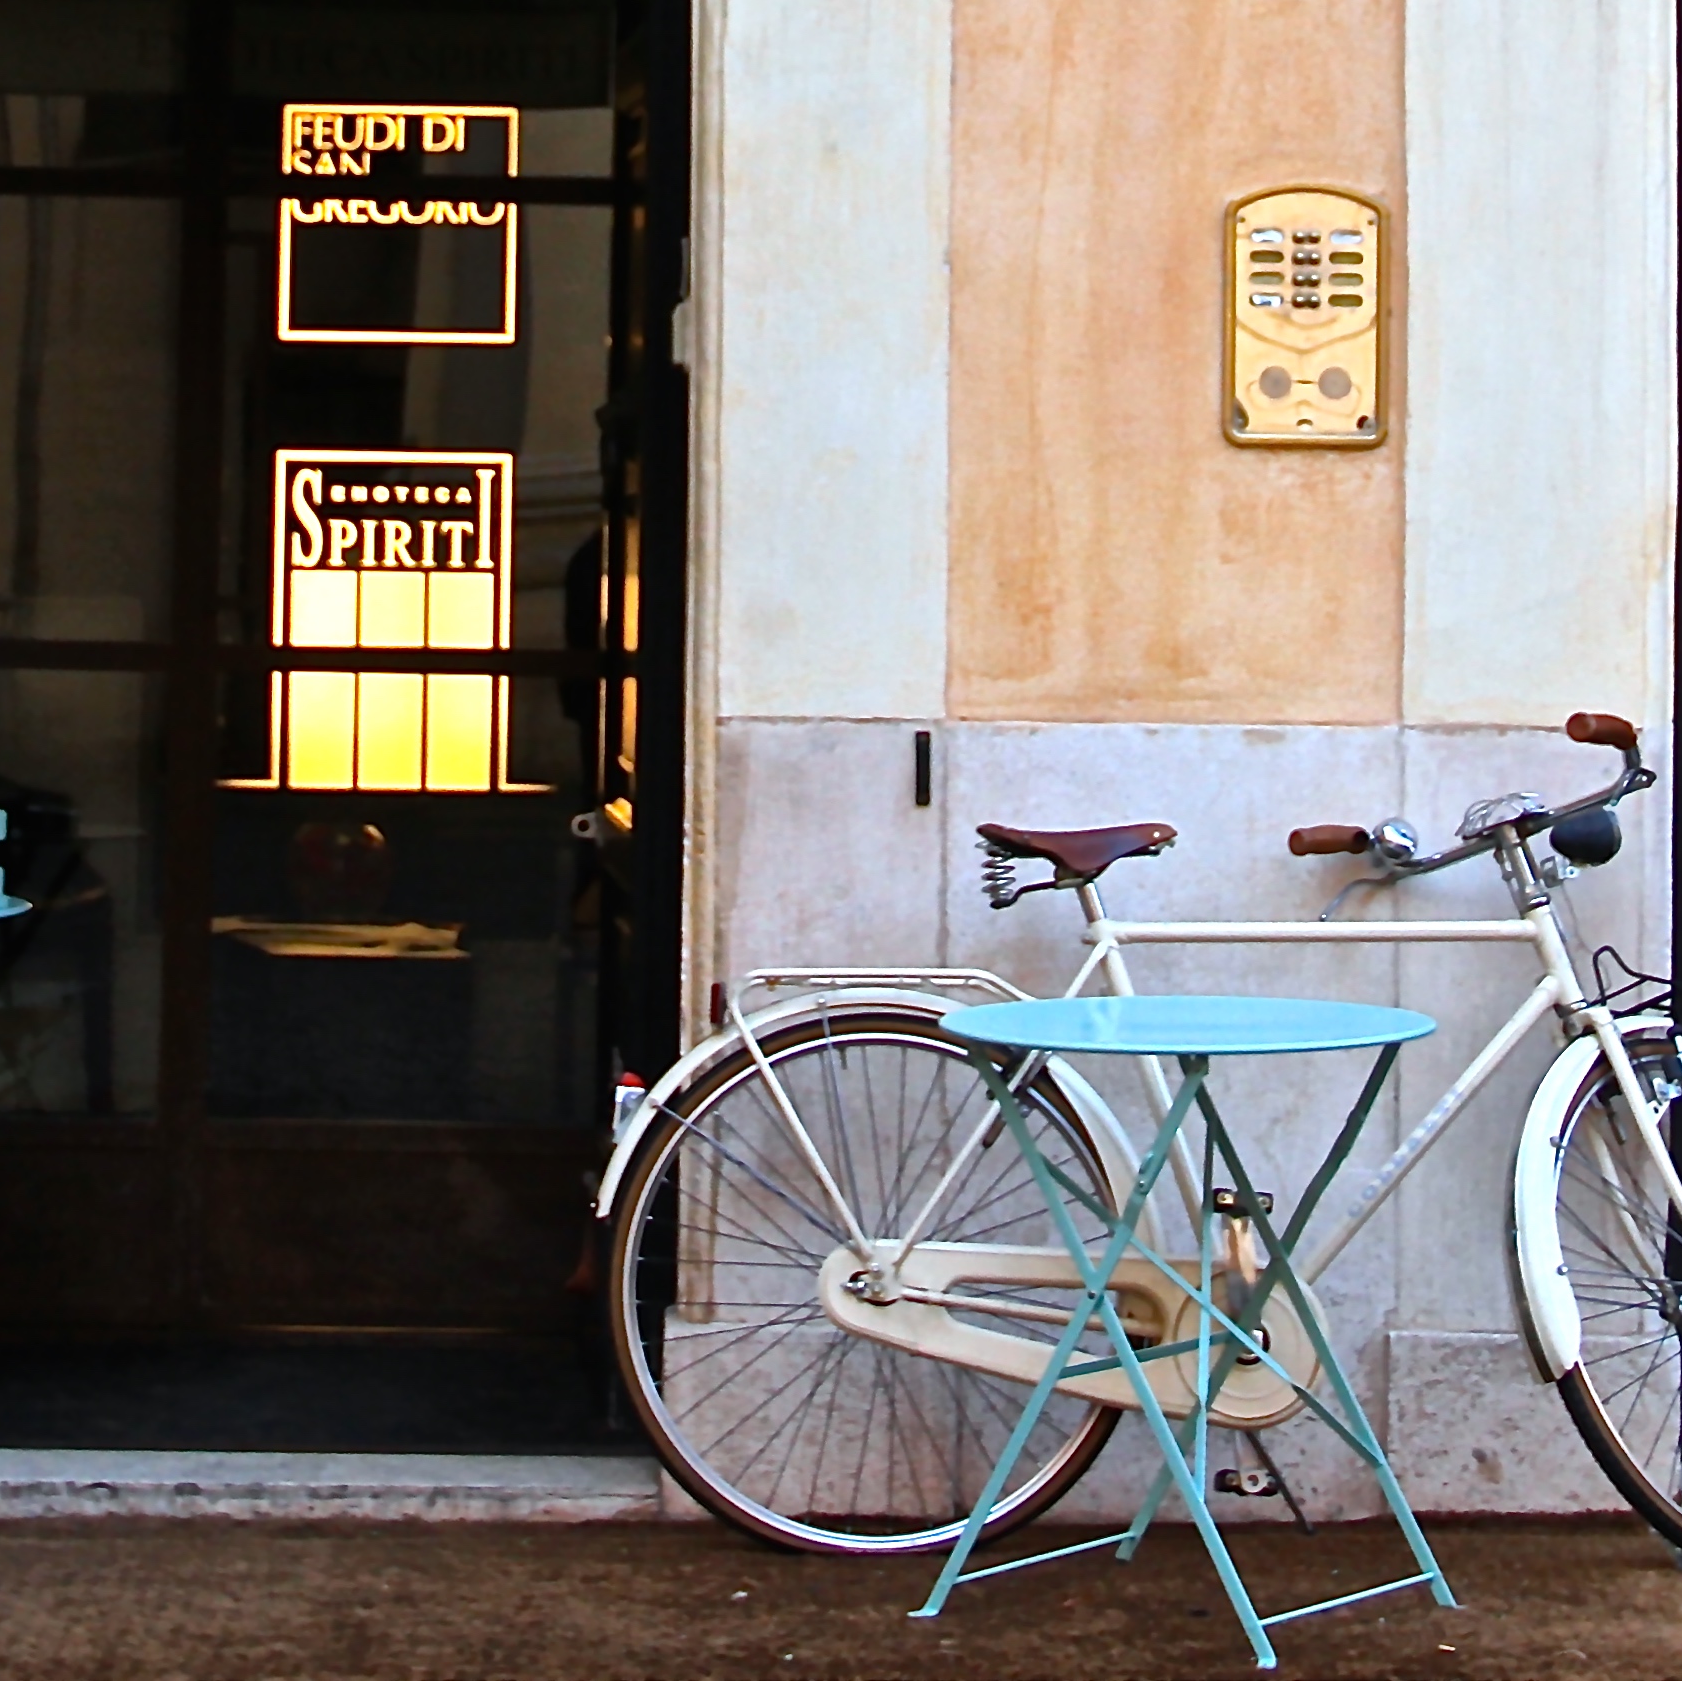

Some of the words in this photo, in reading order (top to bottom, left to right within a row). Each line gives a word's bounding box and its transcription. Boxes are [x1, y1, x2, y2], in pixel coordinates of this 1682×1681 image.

[292, 115, 406, 153] FEUDI
[422, 116, 466, 152] DI
[329, 484, 473, 504] ENOTECA
